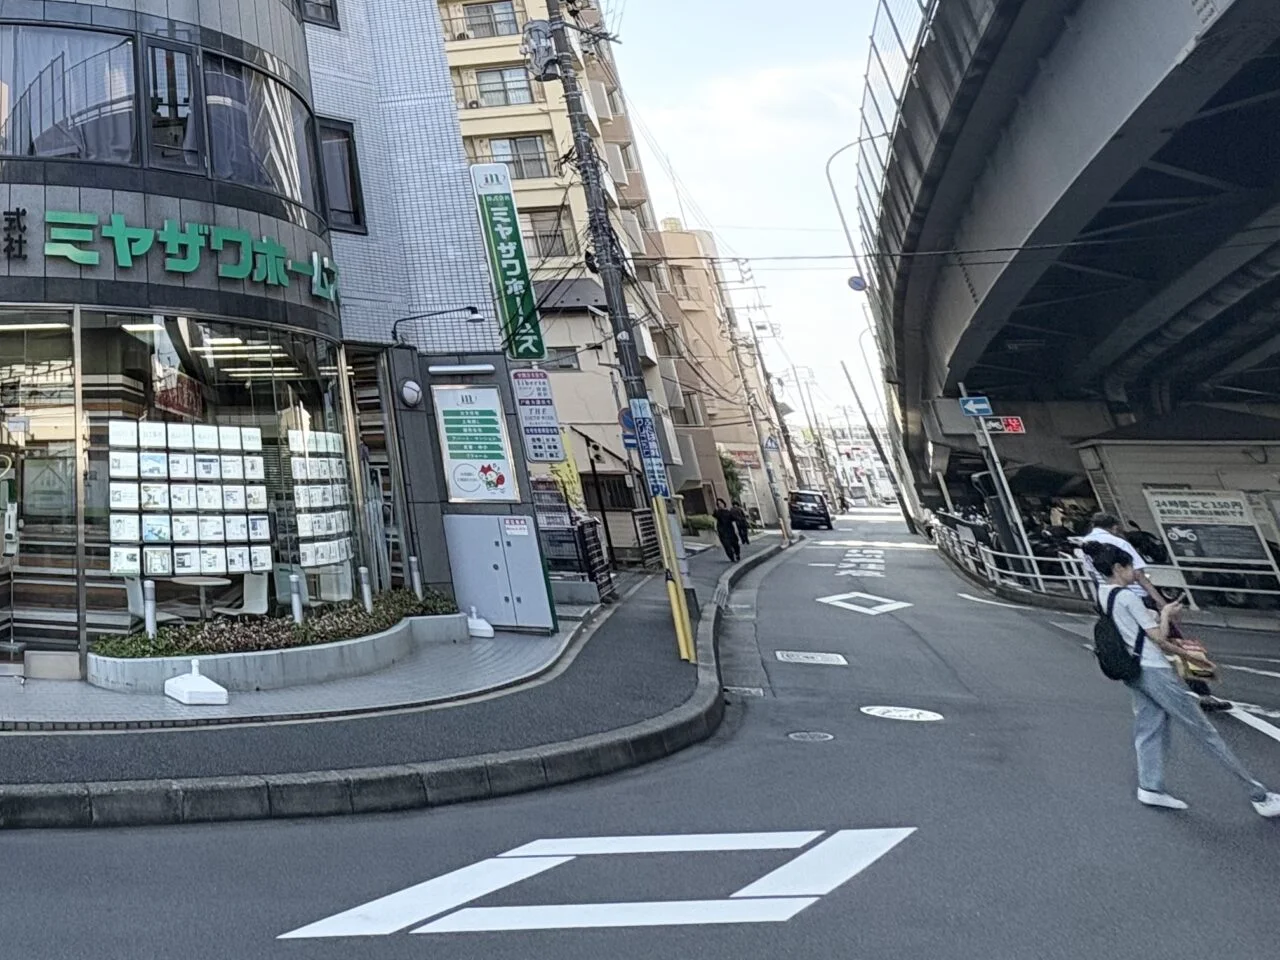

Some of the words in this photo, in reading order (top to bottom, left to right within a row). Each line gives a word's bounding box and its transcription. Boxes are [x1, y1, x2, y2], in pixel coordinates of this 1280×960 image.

[490, 206, 539, 353] ミヤザワホームス
